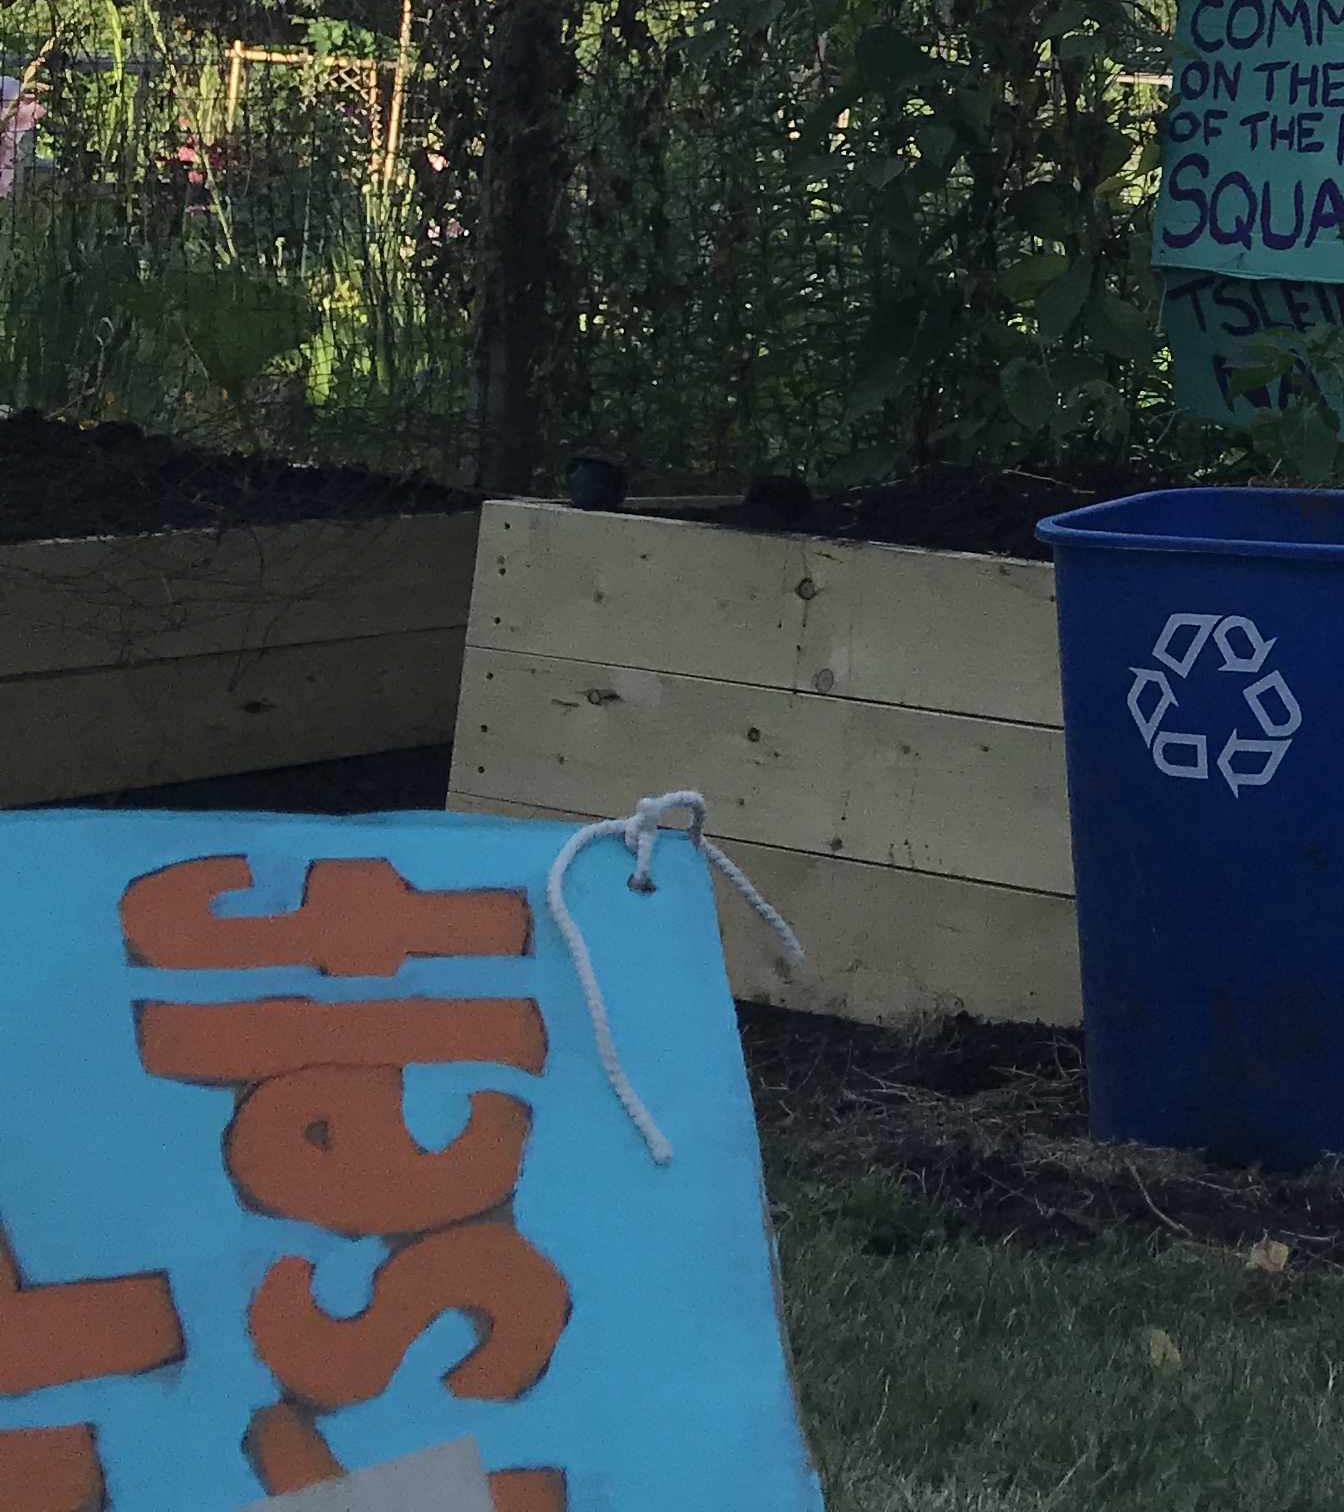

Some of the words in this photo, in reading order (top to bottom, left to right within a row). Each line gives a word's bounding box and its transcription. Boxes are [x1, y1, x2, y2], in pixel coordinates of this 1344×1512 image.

[1180, 59, 1243, 101] ON
[1167, 108, 1229, 147] OF
[1239, 110, 1325, 153] THE
